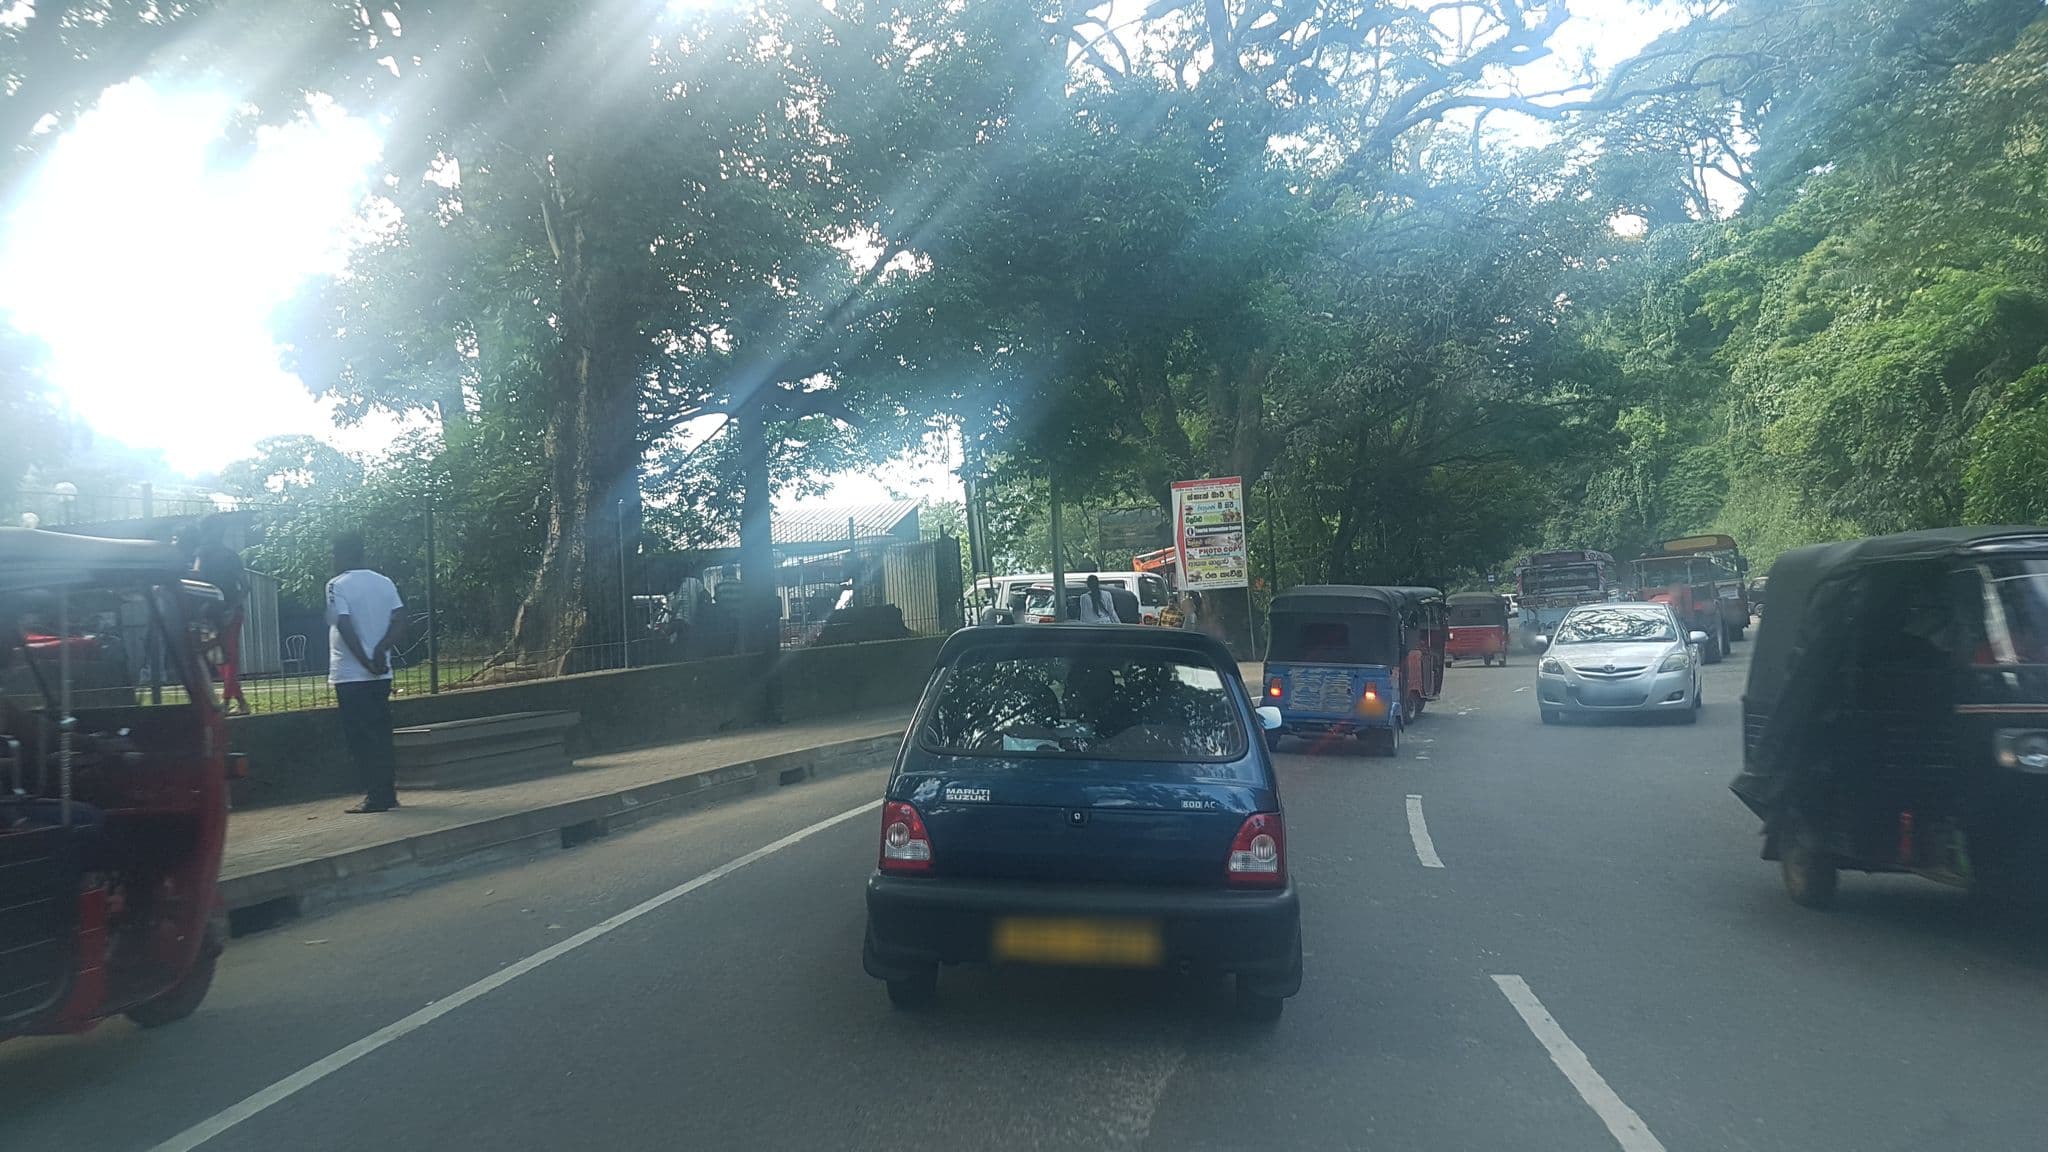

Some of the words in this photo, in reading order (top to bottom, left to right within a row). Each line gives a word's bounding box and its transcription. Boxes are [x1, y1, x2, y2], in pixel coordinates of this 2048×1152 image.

[1199, 547, 1222, 555] PHOTO
[1223, 543, 1242, 553] COPY
[1182, 800, 1201, 809] 800
[1204, 800, 1217, 809] AC
